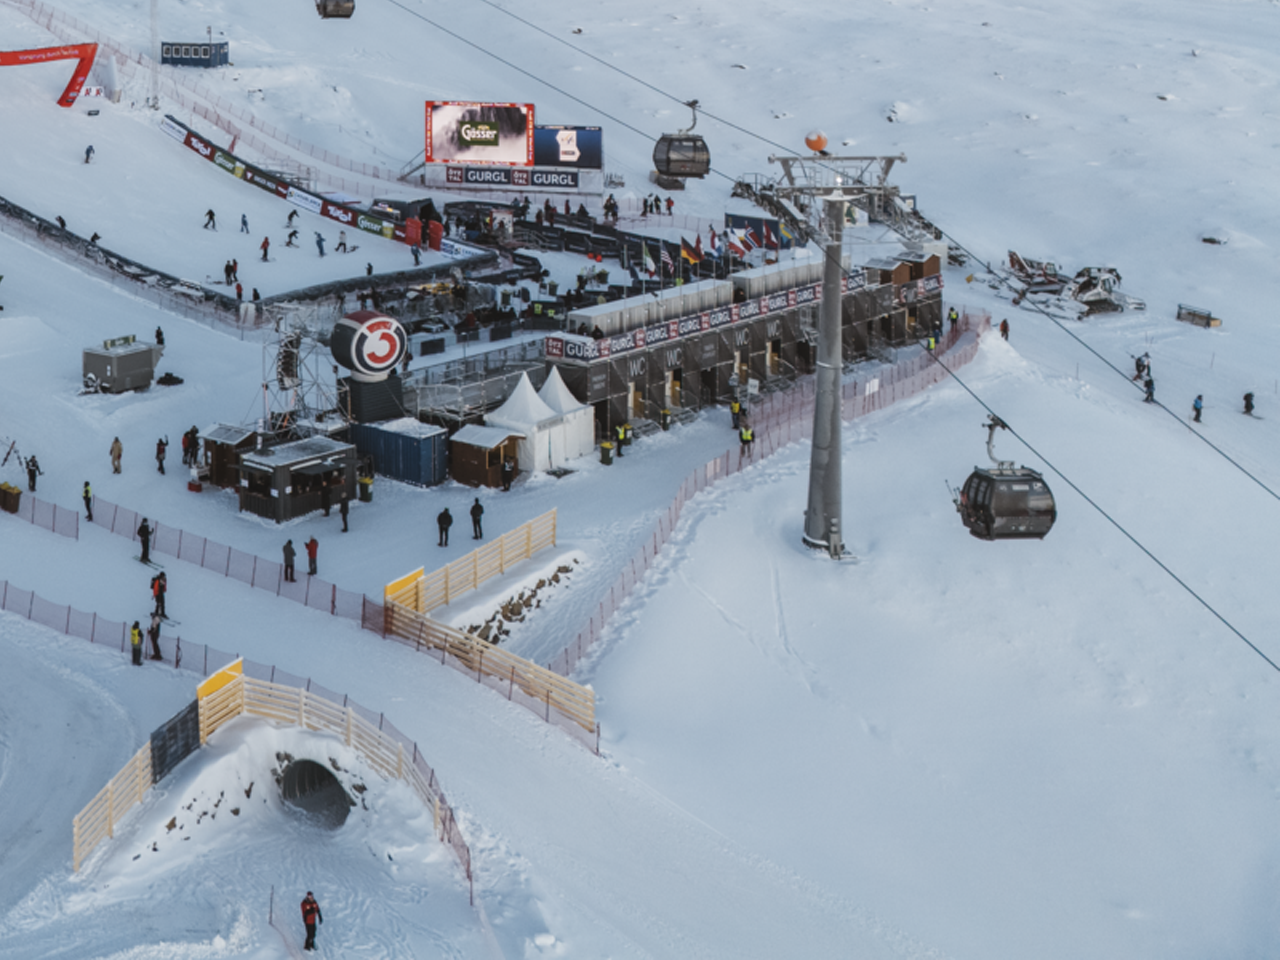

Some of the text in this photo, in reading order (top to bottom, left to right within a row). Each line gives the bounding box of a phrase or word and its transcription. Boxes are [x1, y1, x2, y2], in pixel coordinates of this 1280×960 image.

[461, 124, 497, 141] Gösser
[467, 170, 508, 182] GURGL
[533, 173, 575, 185] GURGL
[667, 348, 682, 367] WC
[629, 357, 646, 377] WC
